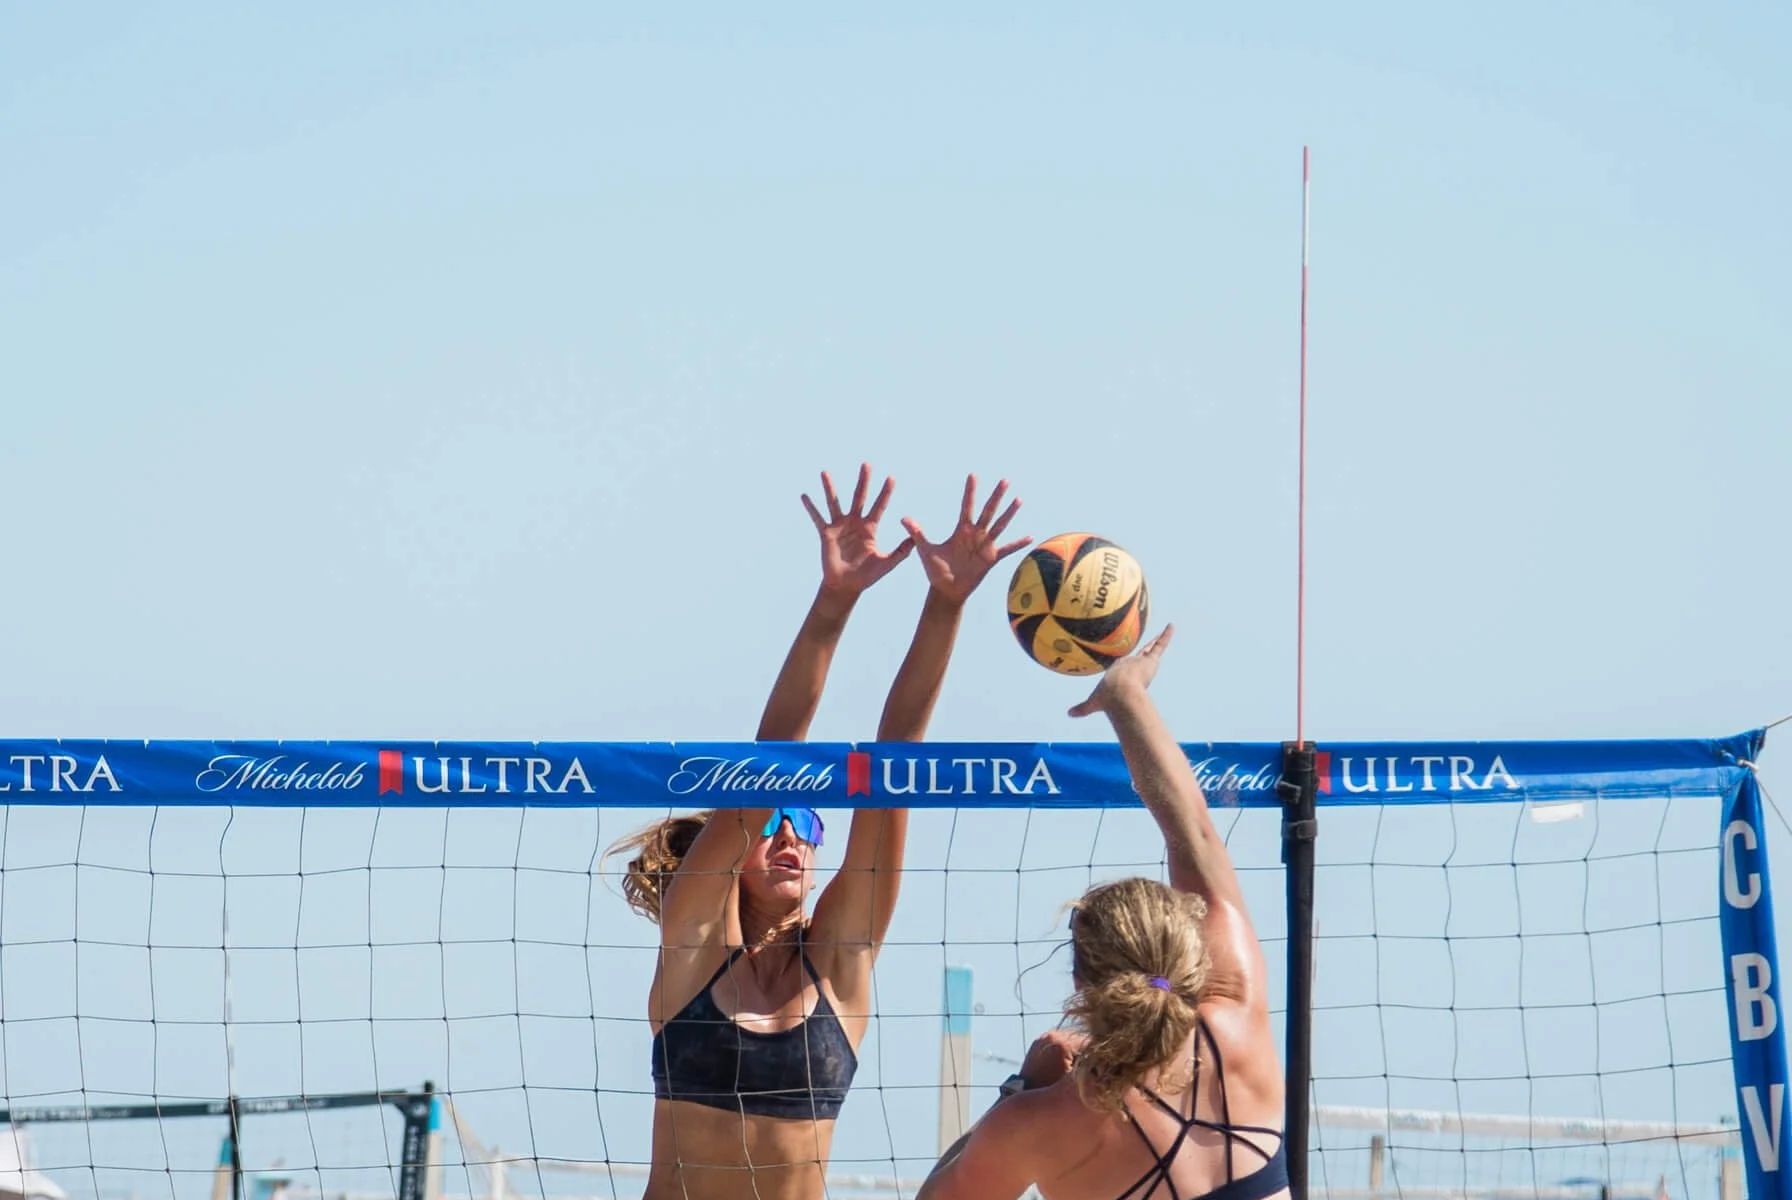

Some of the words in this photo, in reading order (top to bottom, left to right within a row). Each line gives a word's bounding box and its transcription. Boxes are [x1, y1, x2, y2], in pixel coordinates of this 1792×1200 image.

[1093, 552, 1119, 609] Wilson
[195, 754, 366, 793] Michelob
[415, 755, 597, 794] ULTRA
[667, 756, 834, 795] Michelob
[882, 758, 1062, 795] ULTRA
[1187, 756, 1284, 792] ichelo
[1340, 755, 1520, 793] ULTRA
